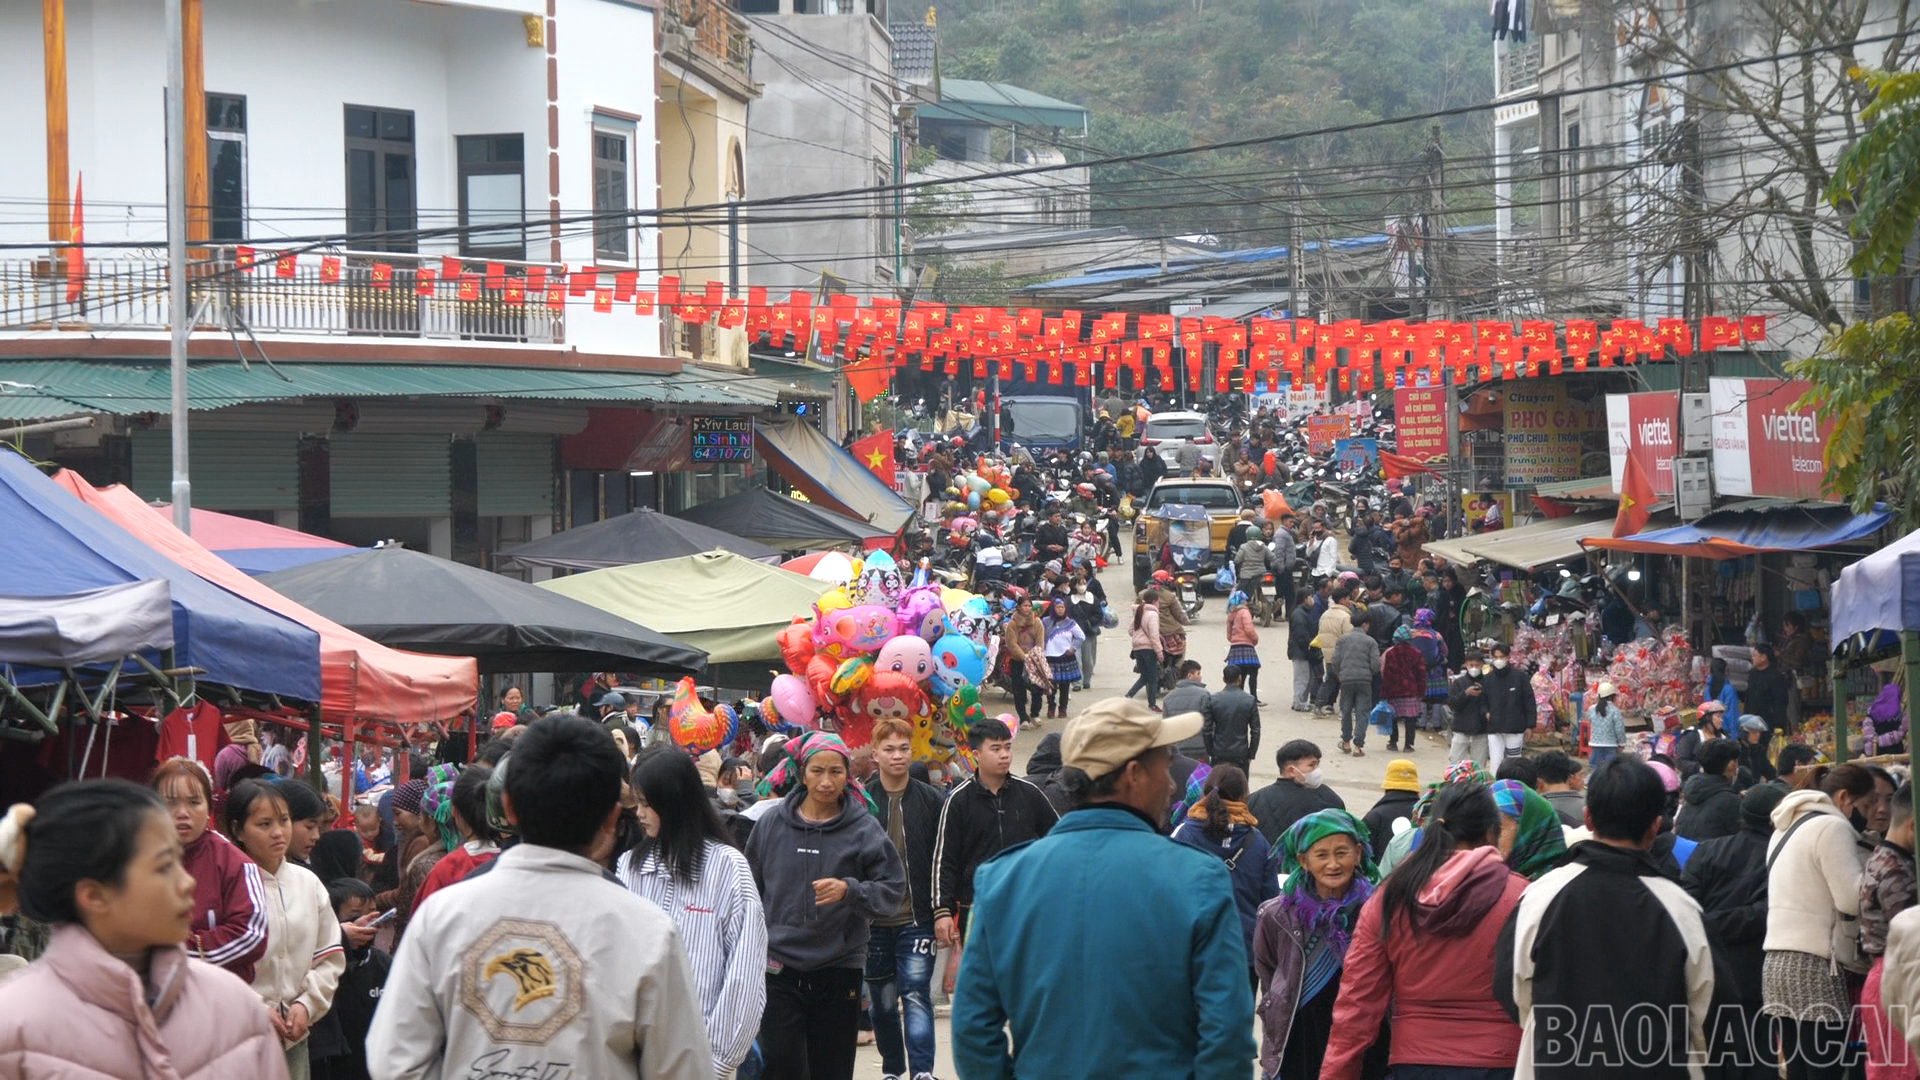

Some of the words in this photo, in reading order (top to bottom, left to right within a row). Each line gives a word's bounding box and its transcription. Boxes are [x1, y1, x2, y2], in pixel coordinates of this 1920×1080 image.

[1553, 405, 1580, 428] GÀ
[1762, 408, 1820, 443] viettel
[710, 433, 737, 445] Sinh
[1638, 417, 1672, 445] viettel
[1792, 455, 1822, 473] telecom
